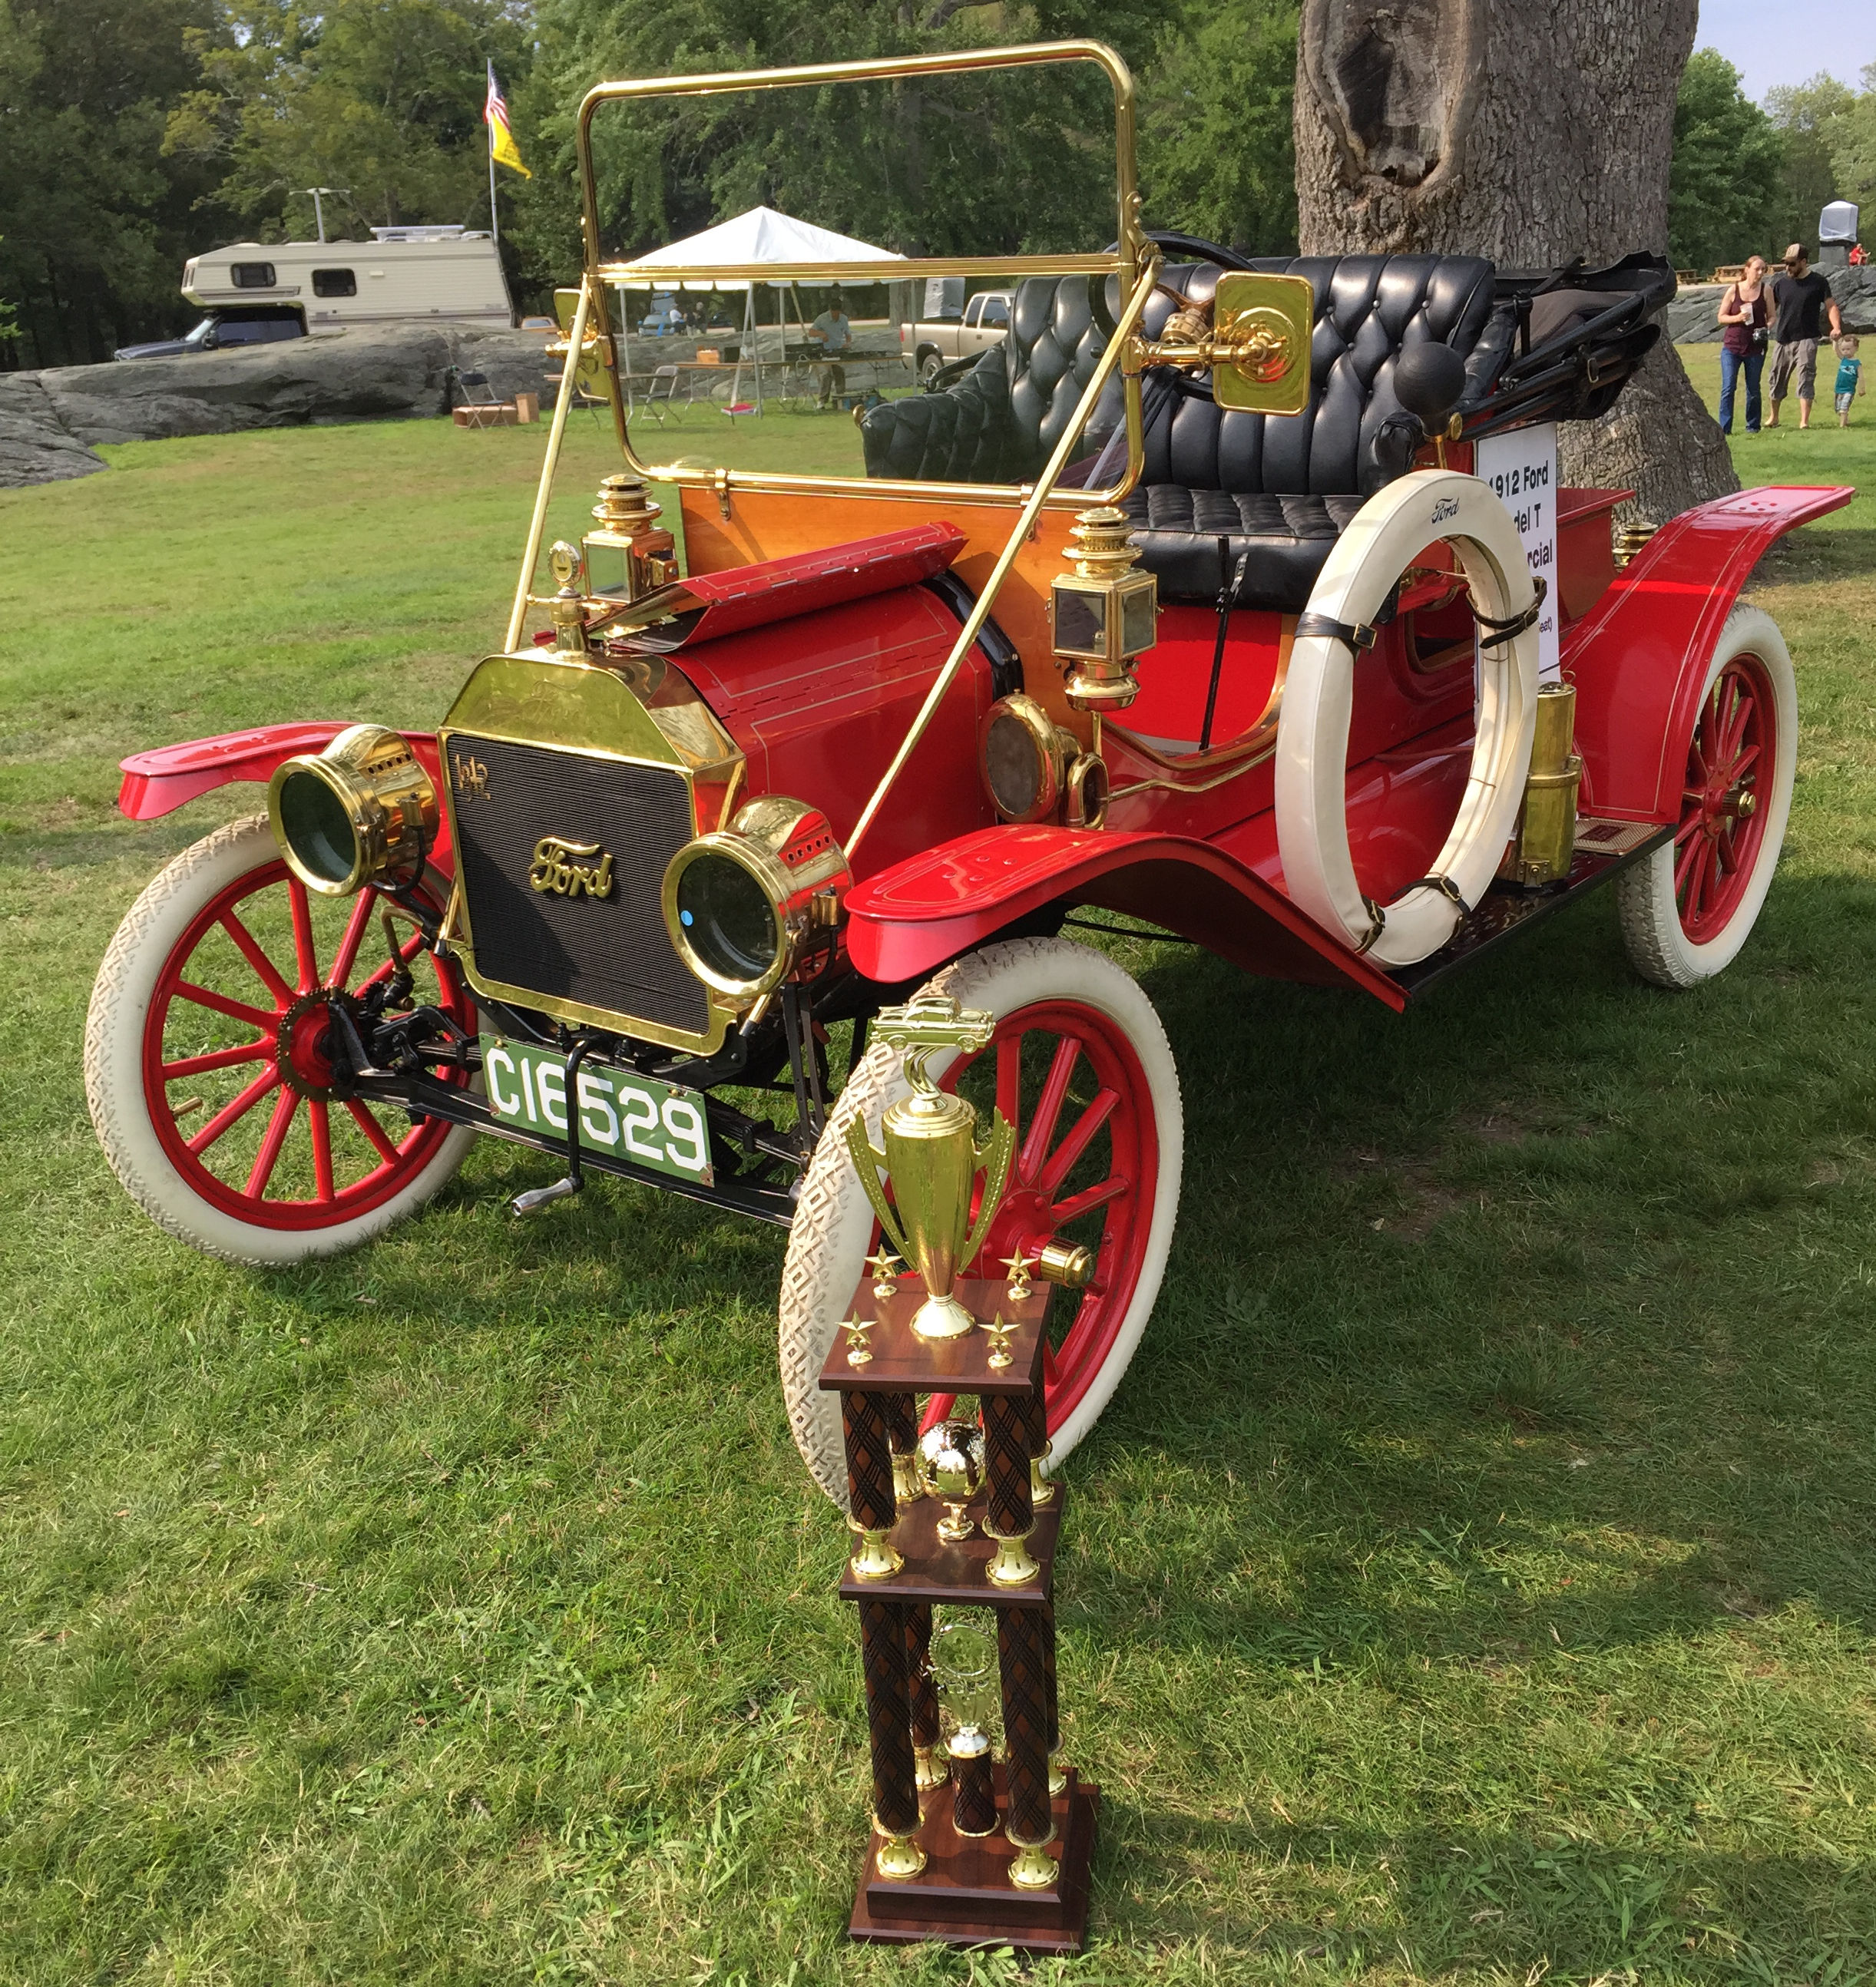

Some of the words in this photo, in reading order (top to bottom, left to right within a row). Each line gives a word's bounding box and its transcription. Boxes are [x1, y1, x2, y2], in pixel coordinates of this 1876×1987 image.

[1524, 459, 1549, 491] Ford
[1431, 497, 1460, 524] Ford
[1514, 506, 1530, 534] del
[1534, 503, 1541, 528] T
[1527, 538, 1553, 569] rcial
[528, 835, 614, 898] Ford
[486, 1047, 707, 1172] C16529
